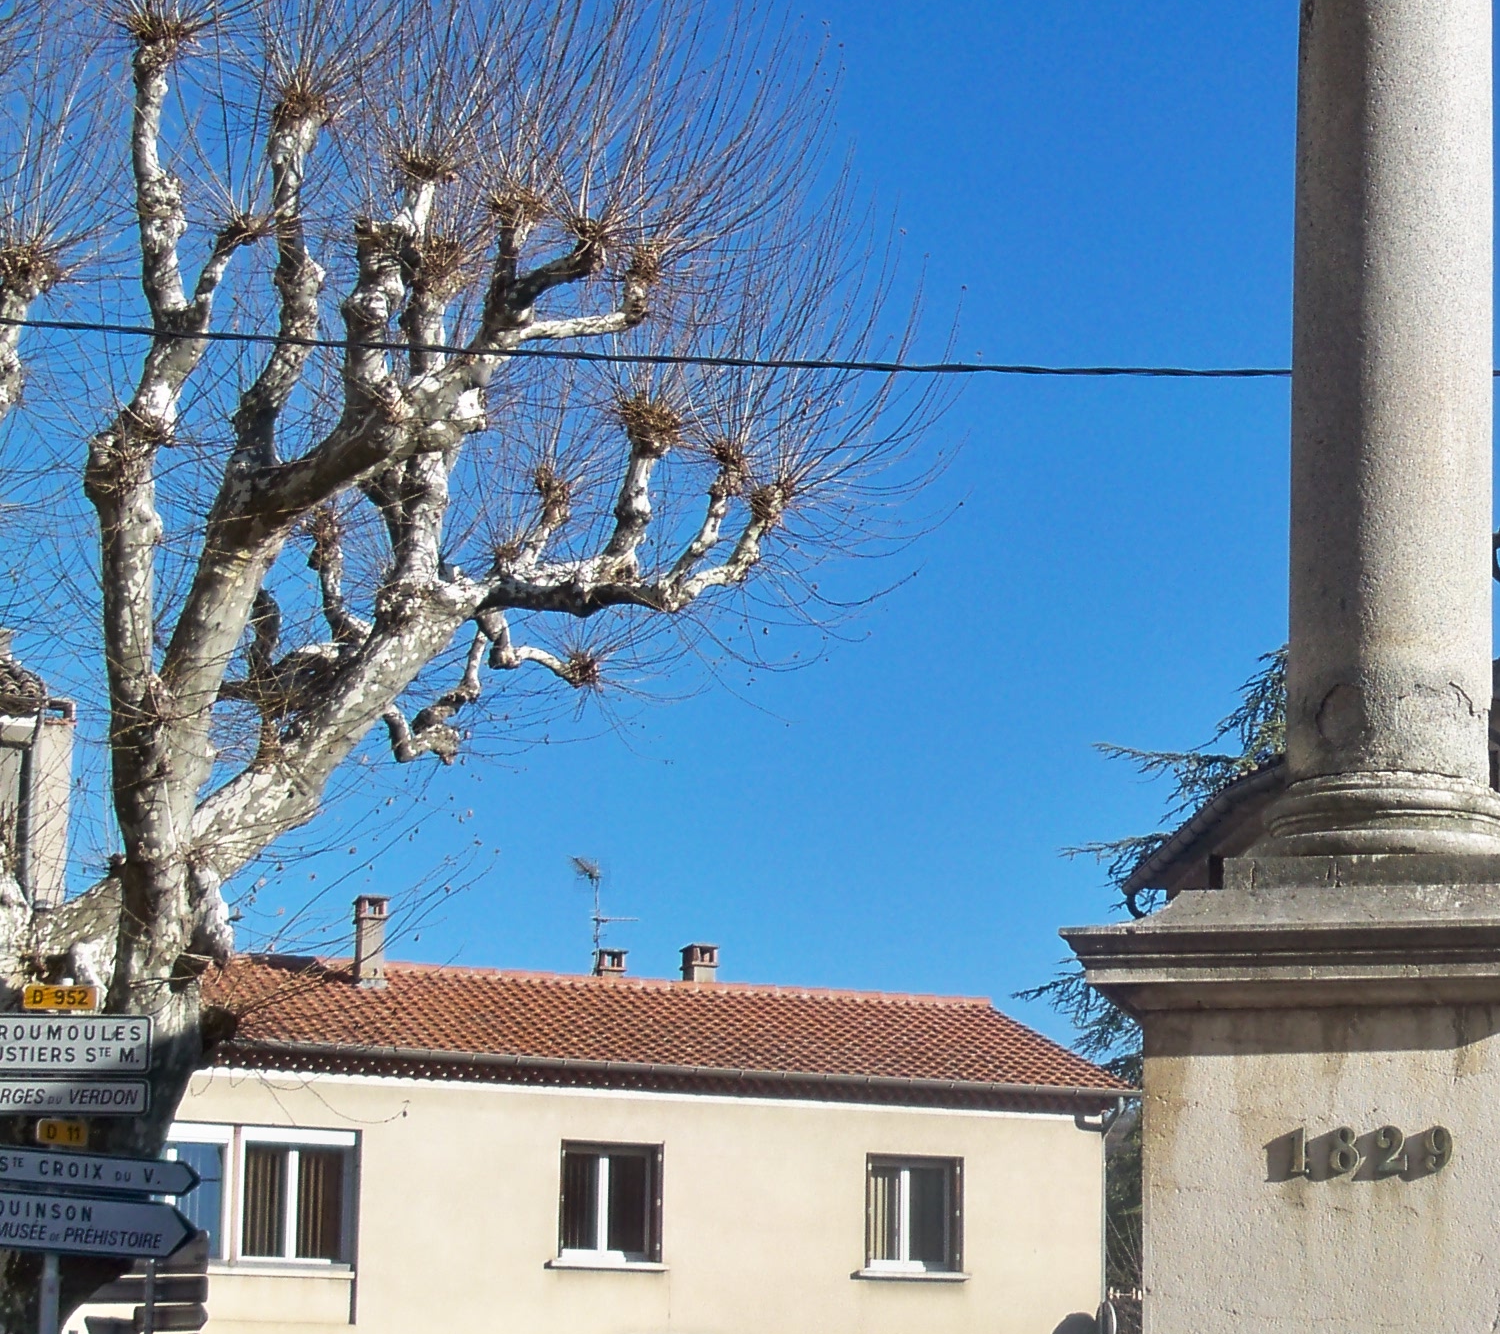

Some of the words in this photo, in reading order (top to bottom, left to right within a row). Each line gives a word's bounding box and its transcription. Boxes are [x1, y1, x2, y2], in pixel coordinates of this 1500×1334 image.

[32, 989, 43, 1005] D
[54, 989, 88, 1006] 952
[0, 1024, 141, 1041] ROUMOULES
[119, 1047, 140, 1063] M.
[69, 1089, 139, 1105] VERDON
[46, 1125, 57, 1140] D
[67, 1126, 80, 1141] 11
[1291, 1125, 1453, 1173] 1829
[39, 1159, 104, 1180] CROIX
[115, 1170, 132, 1182] DU
[143, 1167, 161, 1185] V.
[63, 1226, 163, 1249] PRÉHISTOIRE
